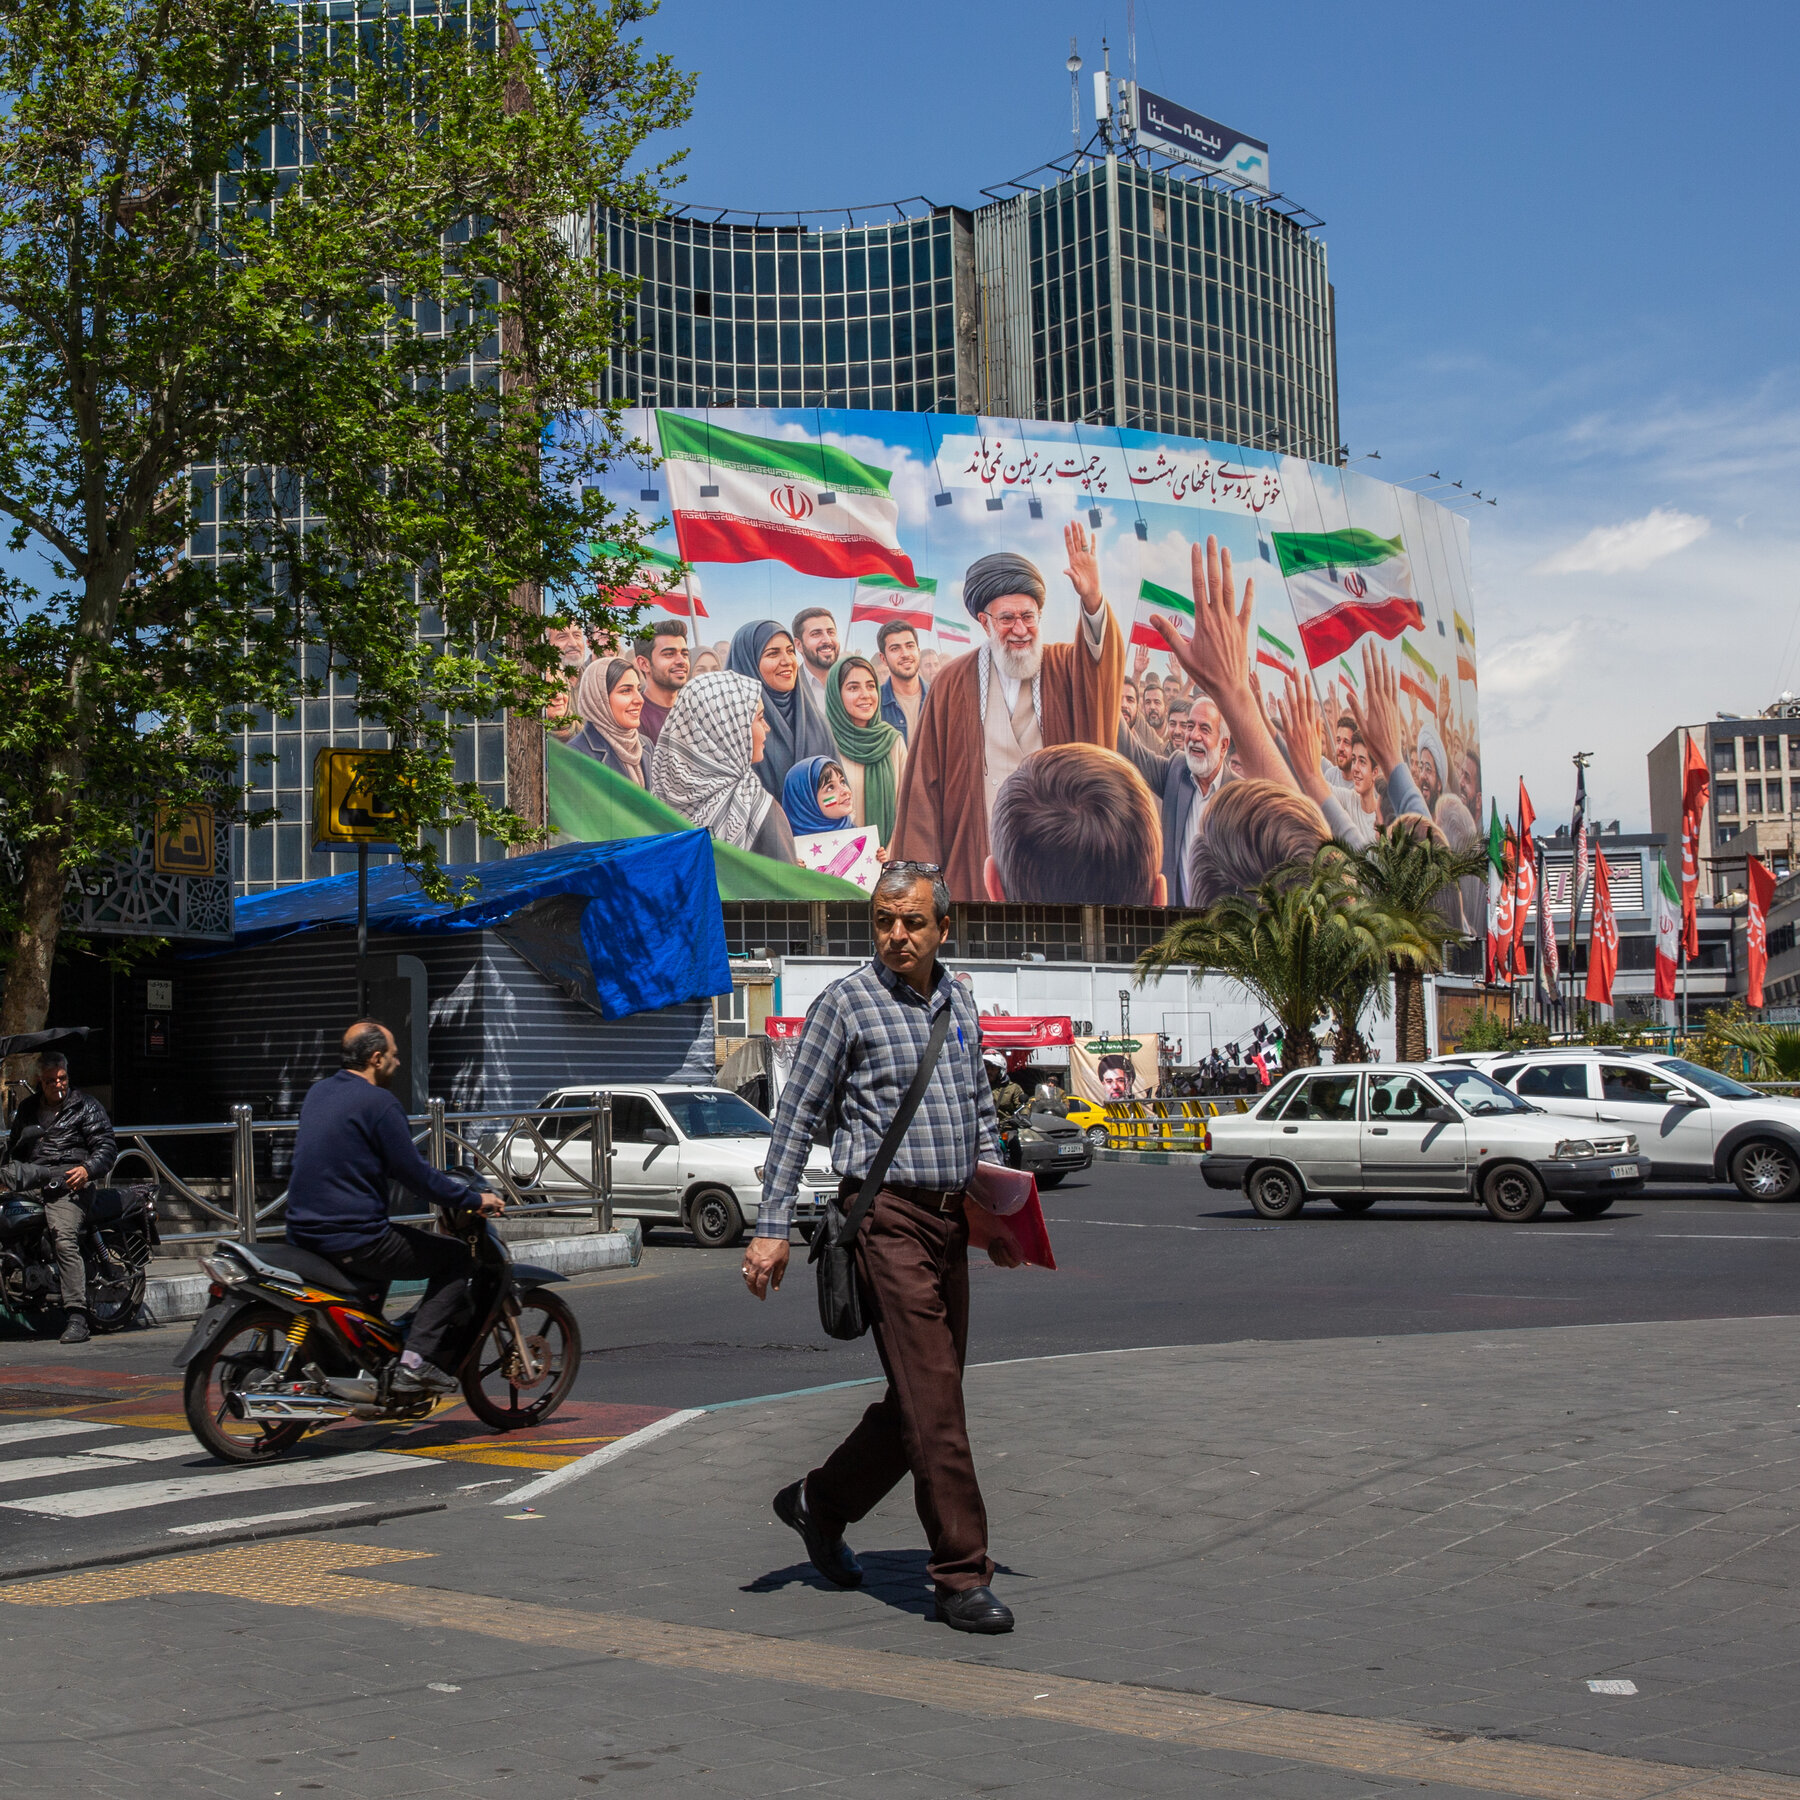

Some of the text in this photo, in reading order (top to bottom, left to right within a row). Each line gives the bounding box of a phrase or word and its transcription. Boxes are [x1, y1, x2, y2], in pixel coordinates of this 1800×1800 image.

[1146, 102, 1222, 155] بیمه سینا
[1002, 452, 1039, 485] زمین
[1039, 461, 1053, 484] بر
[1055, 455, 1108, 493] پرچمت
[1129, 453, 1177, 487] بهشت
[1251, 474, 1281, 513] خوش
[63, 867, 113, 896] Asr
